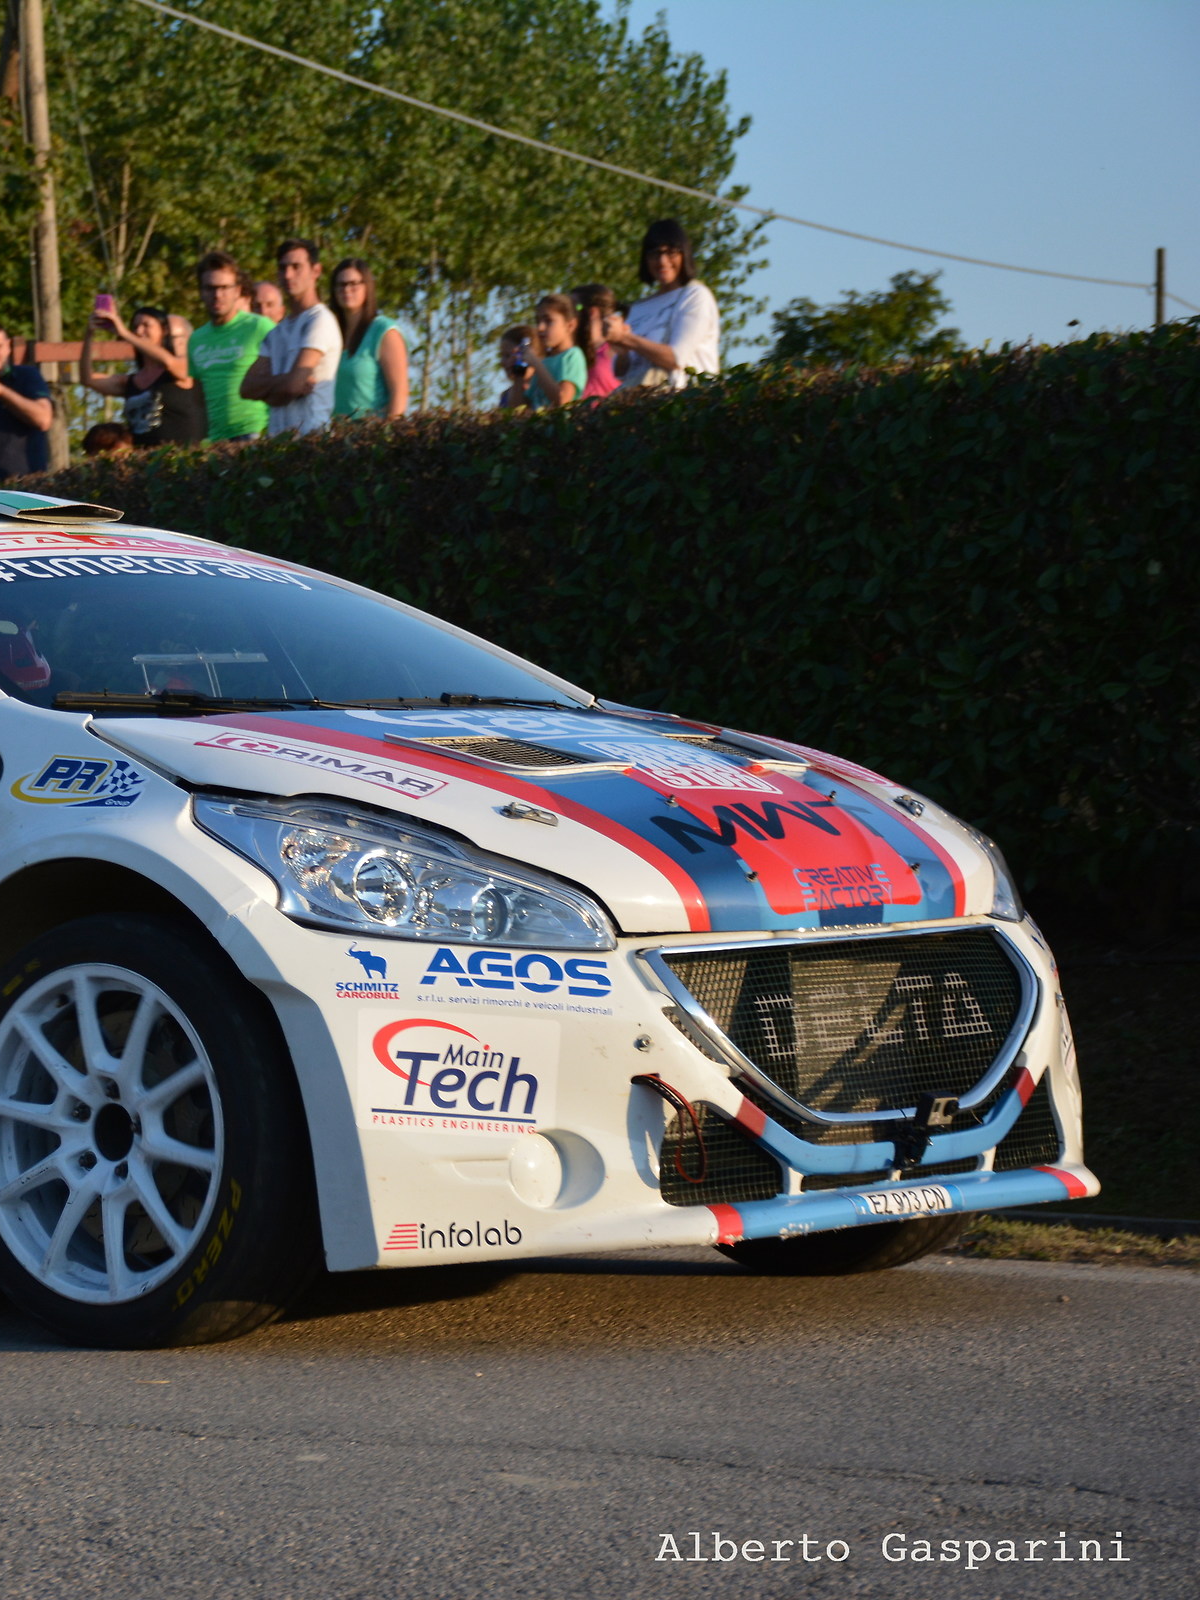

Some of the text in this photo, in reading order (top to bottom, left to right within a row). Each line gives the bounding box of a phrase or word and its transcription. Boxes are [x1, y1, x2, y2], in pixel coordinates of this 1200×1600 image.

[33, 758, 109, 791] PR
[793, 864, 890, 888] CREATIVE
[801, 884, 893, 912] FACTORY
[419, 948, 612, 997] AGOS
[336, 982, 399, 992] SCHMITZ
[336, 991, 400, 1000] CARGOBULL
[448, 996, 480, 1005] servizi
[482, 998, 523, 1009] rimorchi
[533, 1001, 564, 1011] veicoli
[566, 1004, 613, 1016] industriali
[443, 1043, 503, 1068] Main
[396, 1050, 538, 1115] Tech
[372, 1115, 538, 1135] PLASTICS ENGINEERING
[867, 1185, 947, 1214] EZ 913 CN
[420, 1219, 523, 1249] infolab
